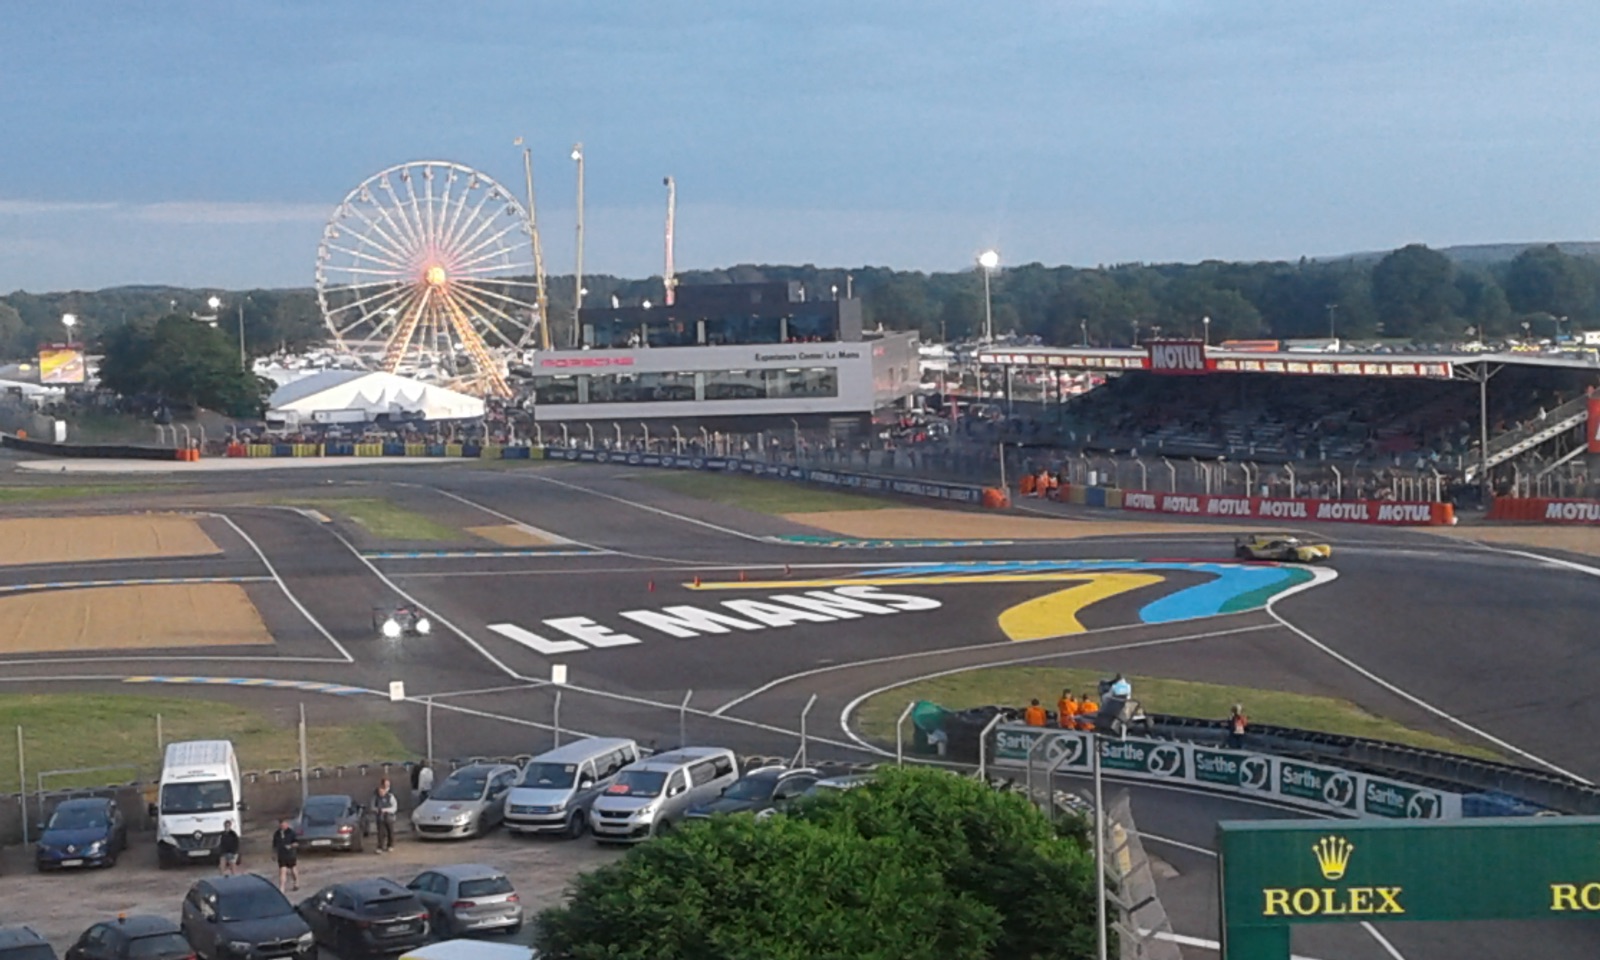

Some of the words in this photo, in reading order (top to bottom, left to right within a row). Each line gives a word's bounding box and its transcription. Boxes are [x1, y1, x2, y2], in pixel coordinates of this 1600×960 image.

[1152, 344, 1204, 370] MOTUL
[1125, 493, 1156, 510] MOTUL
[1162, 496, 1200, 513] MOTUL
[1207, 498, 1250, 515] MOTUL
[1259, 500, 1307, 517] MOTUL
[1317, 503, 1369, 520] MOTUL
[1377, 504, 1431, 521] MOTUL
[486, 616, 643, 655] LE
[618, 586, 943, 638] MANS
[1101, 741, 1144, 762] Sarthe
[1196, 753, 1237, 773] Sarthe
[1282, 765, 1321, 790] Sarthe
[1367, 783, 1404, 808] Sarthe
[1262, 886, 1405, 916] ROLEX
